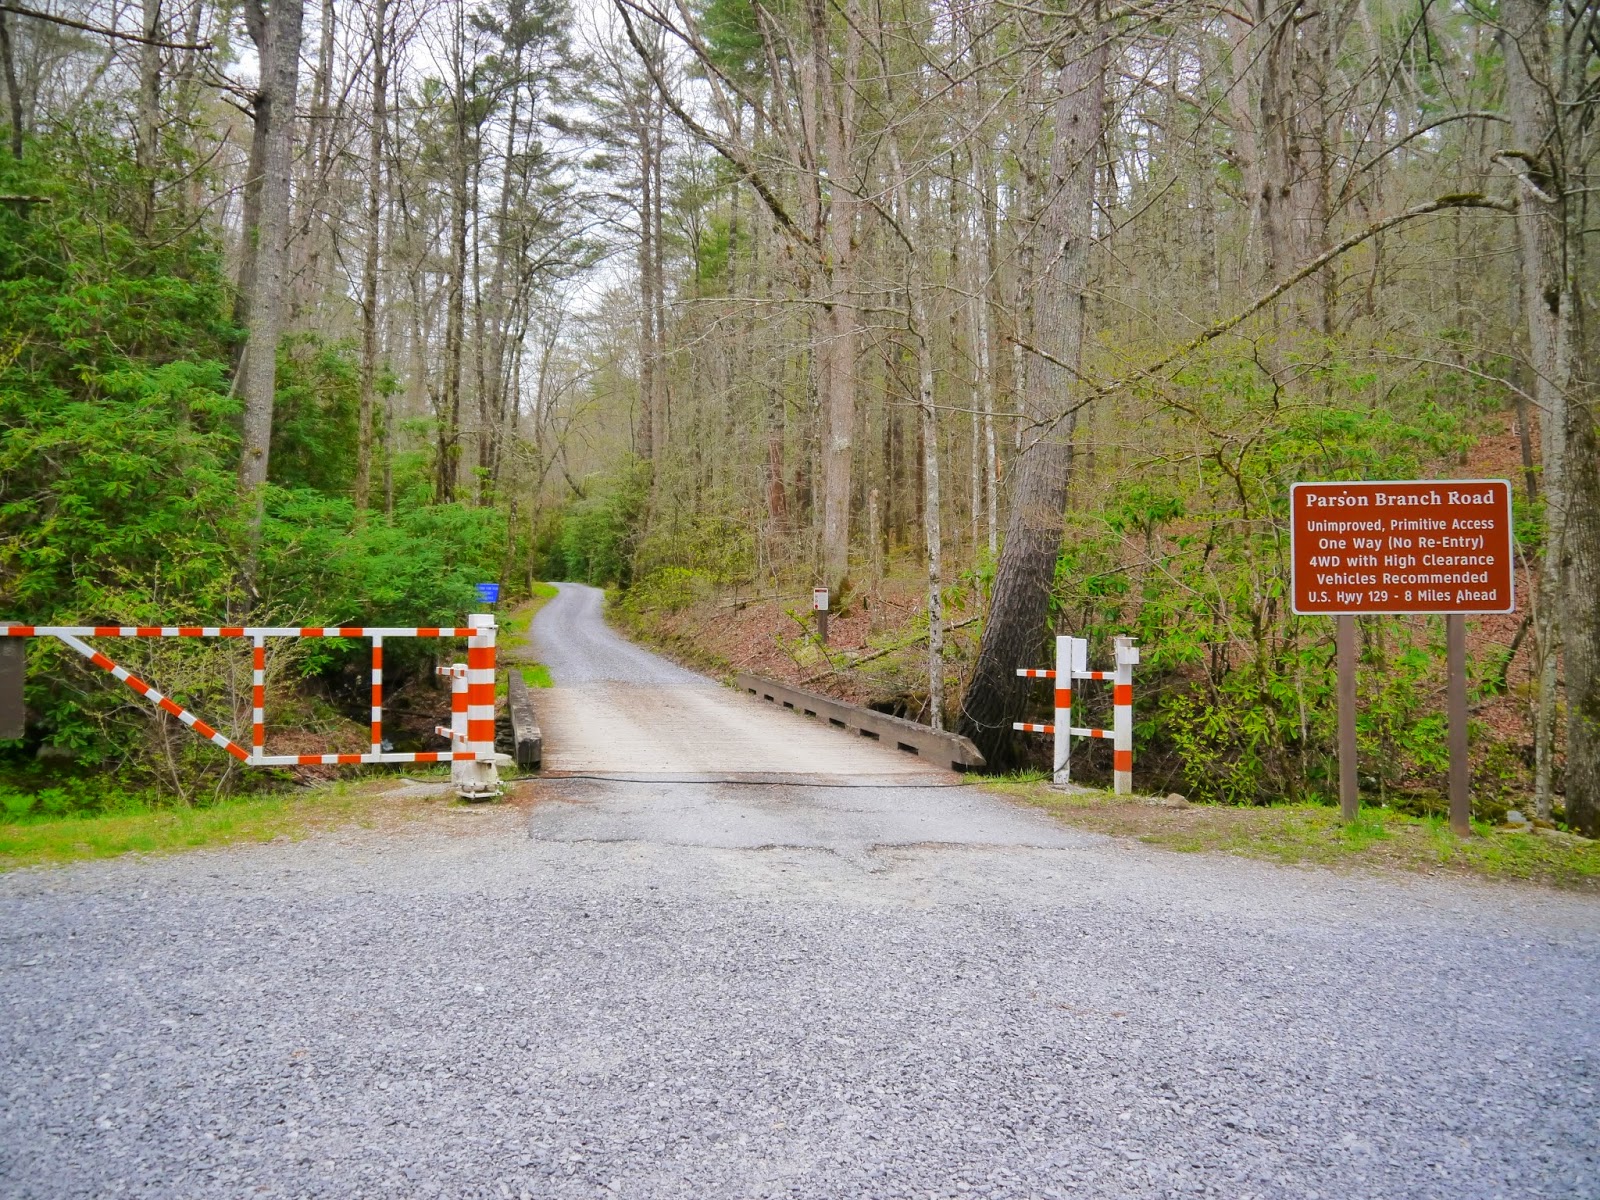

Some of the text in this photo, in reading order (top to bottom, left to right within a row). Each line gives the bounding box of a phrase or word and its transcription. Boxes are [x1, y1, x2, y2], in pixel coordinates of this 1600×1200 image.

[1306, 490, 1495, 507] Parson Branch Road
[1307, 518, 1494, 533] Unimproved, Primitive Access
[1319, 535, 1484, 551] One Way (No Re-Entry)
[1309, 554, 1495, 569] 4WD with High Clearance
[1317, 571, 1488, 585] Vehicles Recommended
[1308, 592, 1331, 603] U.S.
[1337, 591, 1363, 605] Hwy
[1368, 591, 1388, 602] 129
[1404, 591, 1412, 601] 8
[1418, 590, 1451, 602] Miles
[1456, 589, 1497, 602] Ahead
